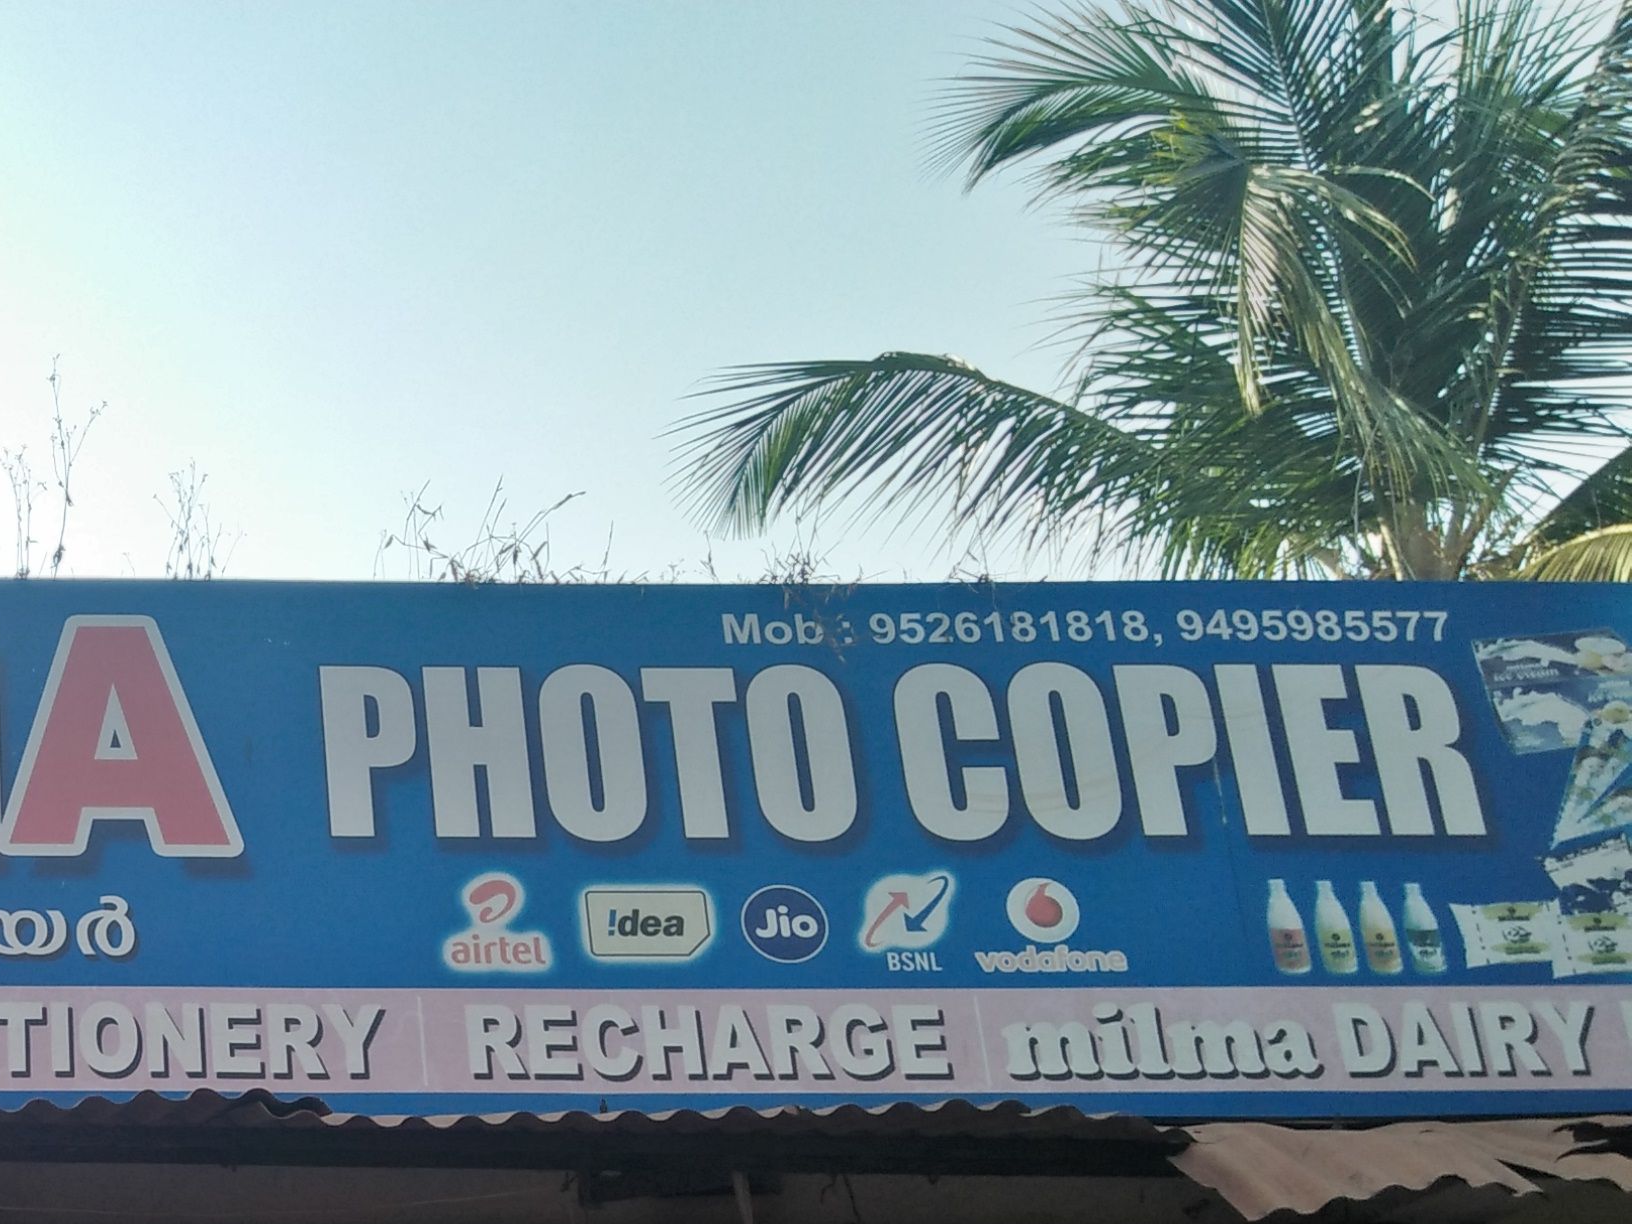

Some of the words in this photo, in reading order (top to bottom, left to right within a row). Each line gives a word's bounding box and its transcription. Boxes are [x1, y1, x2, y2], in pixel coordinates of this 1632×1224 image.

[722, 612, 824, 645] Mob
[869, 611, 1164, 649] 9526181818,
[1175, 609, 1450, 644] 9495985577
[319, 663, 858, 842] PHOTO
[892, 661, 1488, 843] COPIER
[755, 907, 816, 940] Jio
[450, 937, 547, 966] airtel
[886, 951, 944, 973] BSNL
[973, 947, 1130, 974] vodafone
[466, 1003, 955, 1083] RECHARGE
[1000, 999, 1325, 1084] milma
[1337, 1001, 1596, 1081] DAIRY
